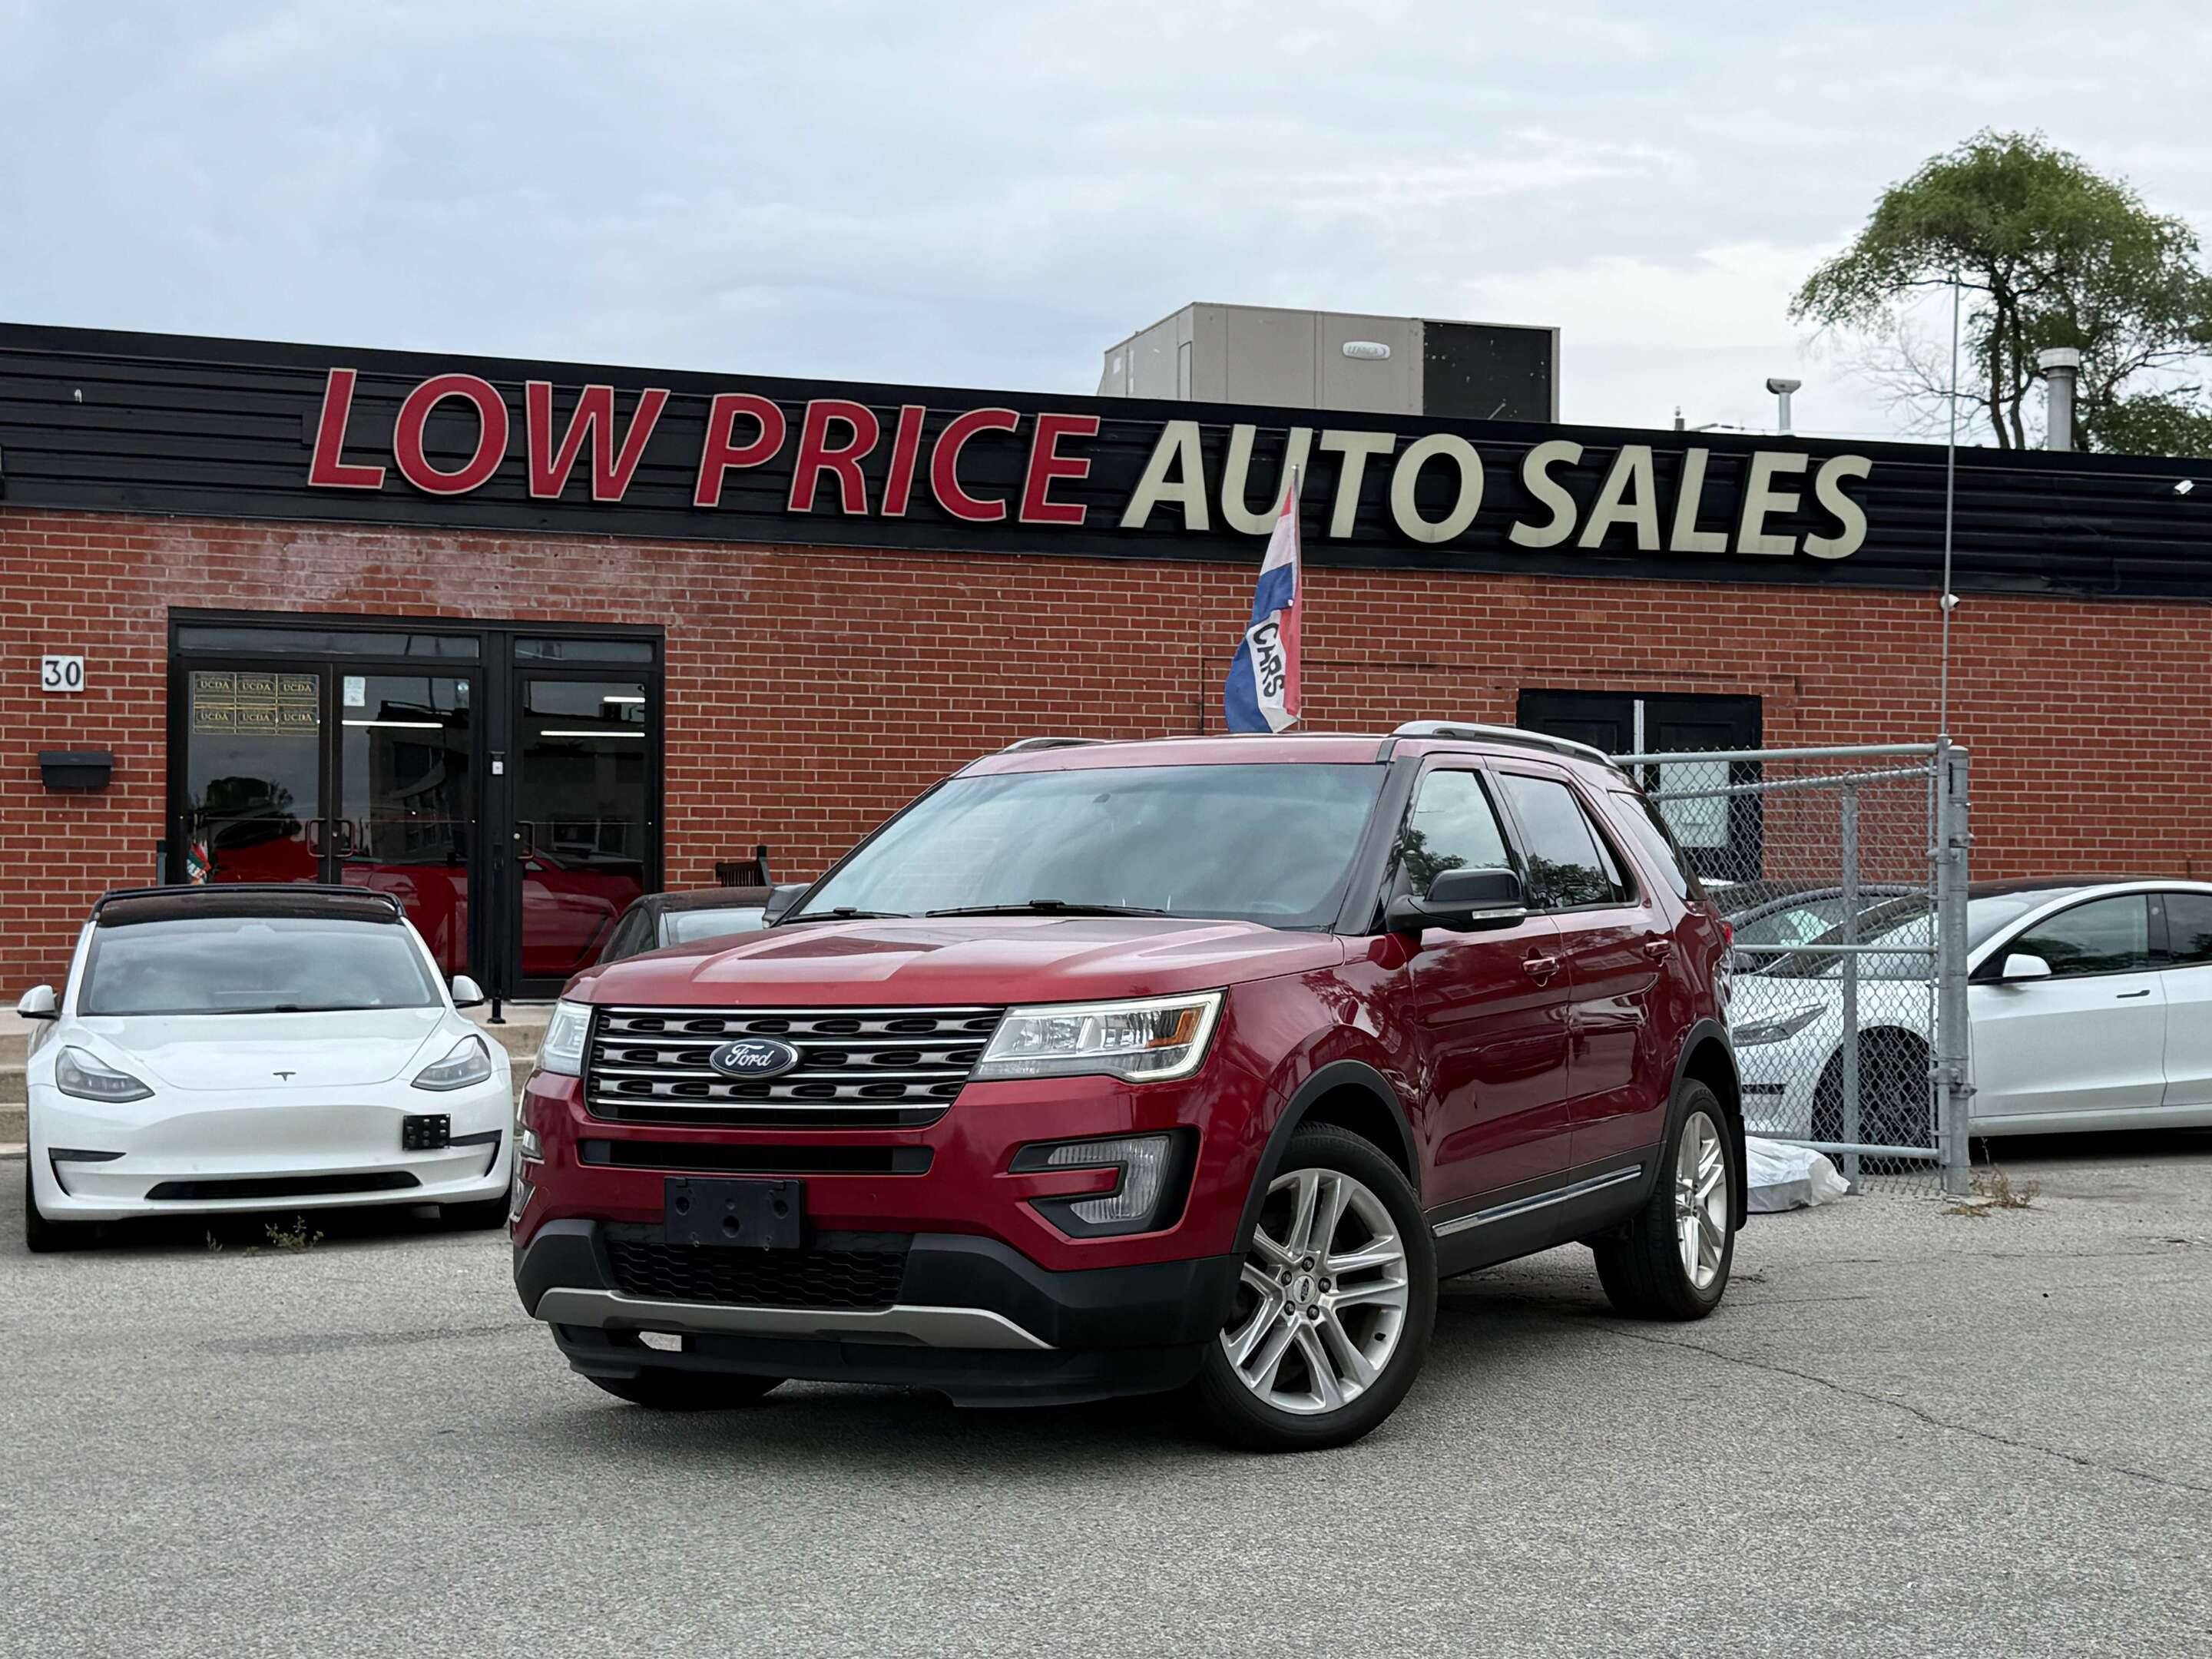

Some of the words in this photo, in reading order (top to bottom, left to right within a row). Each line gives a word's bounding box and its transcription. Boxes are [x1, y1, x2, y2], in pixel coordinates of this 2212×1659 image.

[307, 367, 671, 502] LOW
[694, 392, 1101, 525] PRICE
[1119, 419, 1485, 543] AUTO
[1508, 439, 1873, 559] SALES
[1253, 622, 1285, 697] CARS
[45, 661, 81, 687] 30
[200, 680, 230, 689] UCDA
[243, 681, 271, 690] UCDA
[283, 683, 312, 693] UCDA
[200, 712, 229, 720] UCDA
[243, 713, 270, 722] UCDA
[283, 713, 312, 722] UCDA
[725, 1044, 775, 1067] Ford
